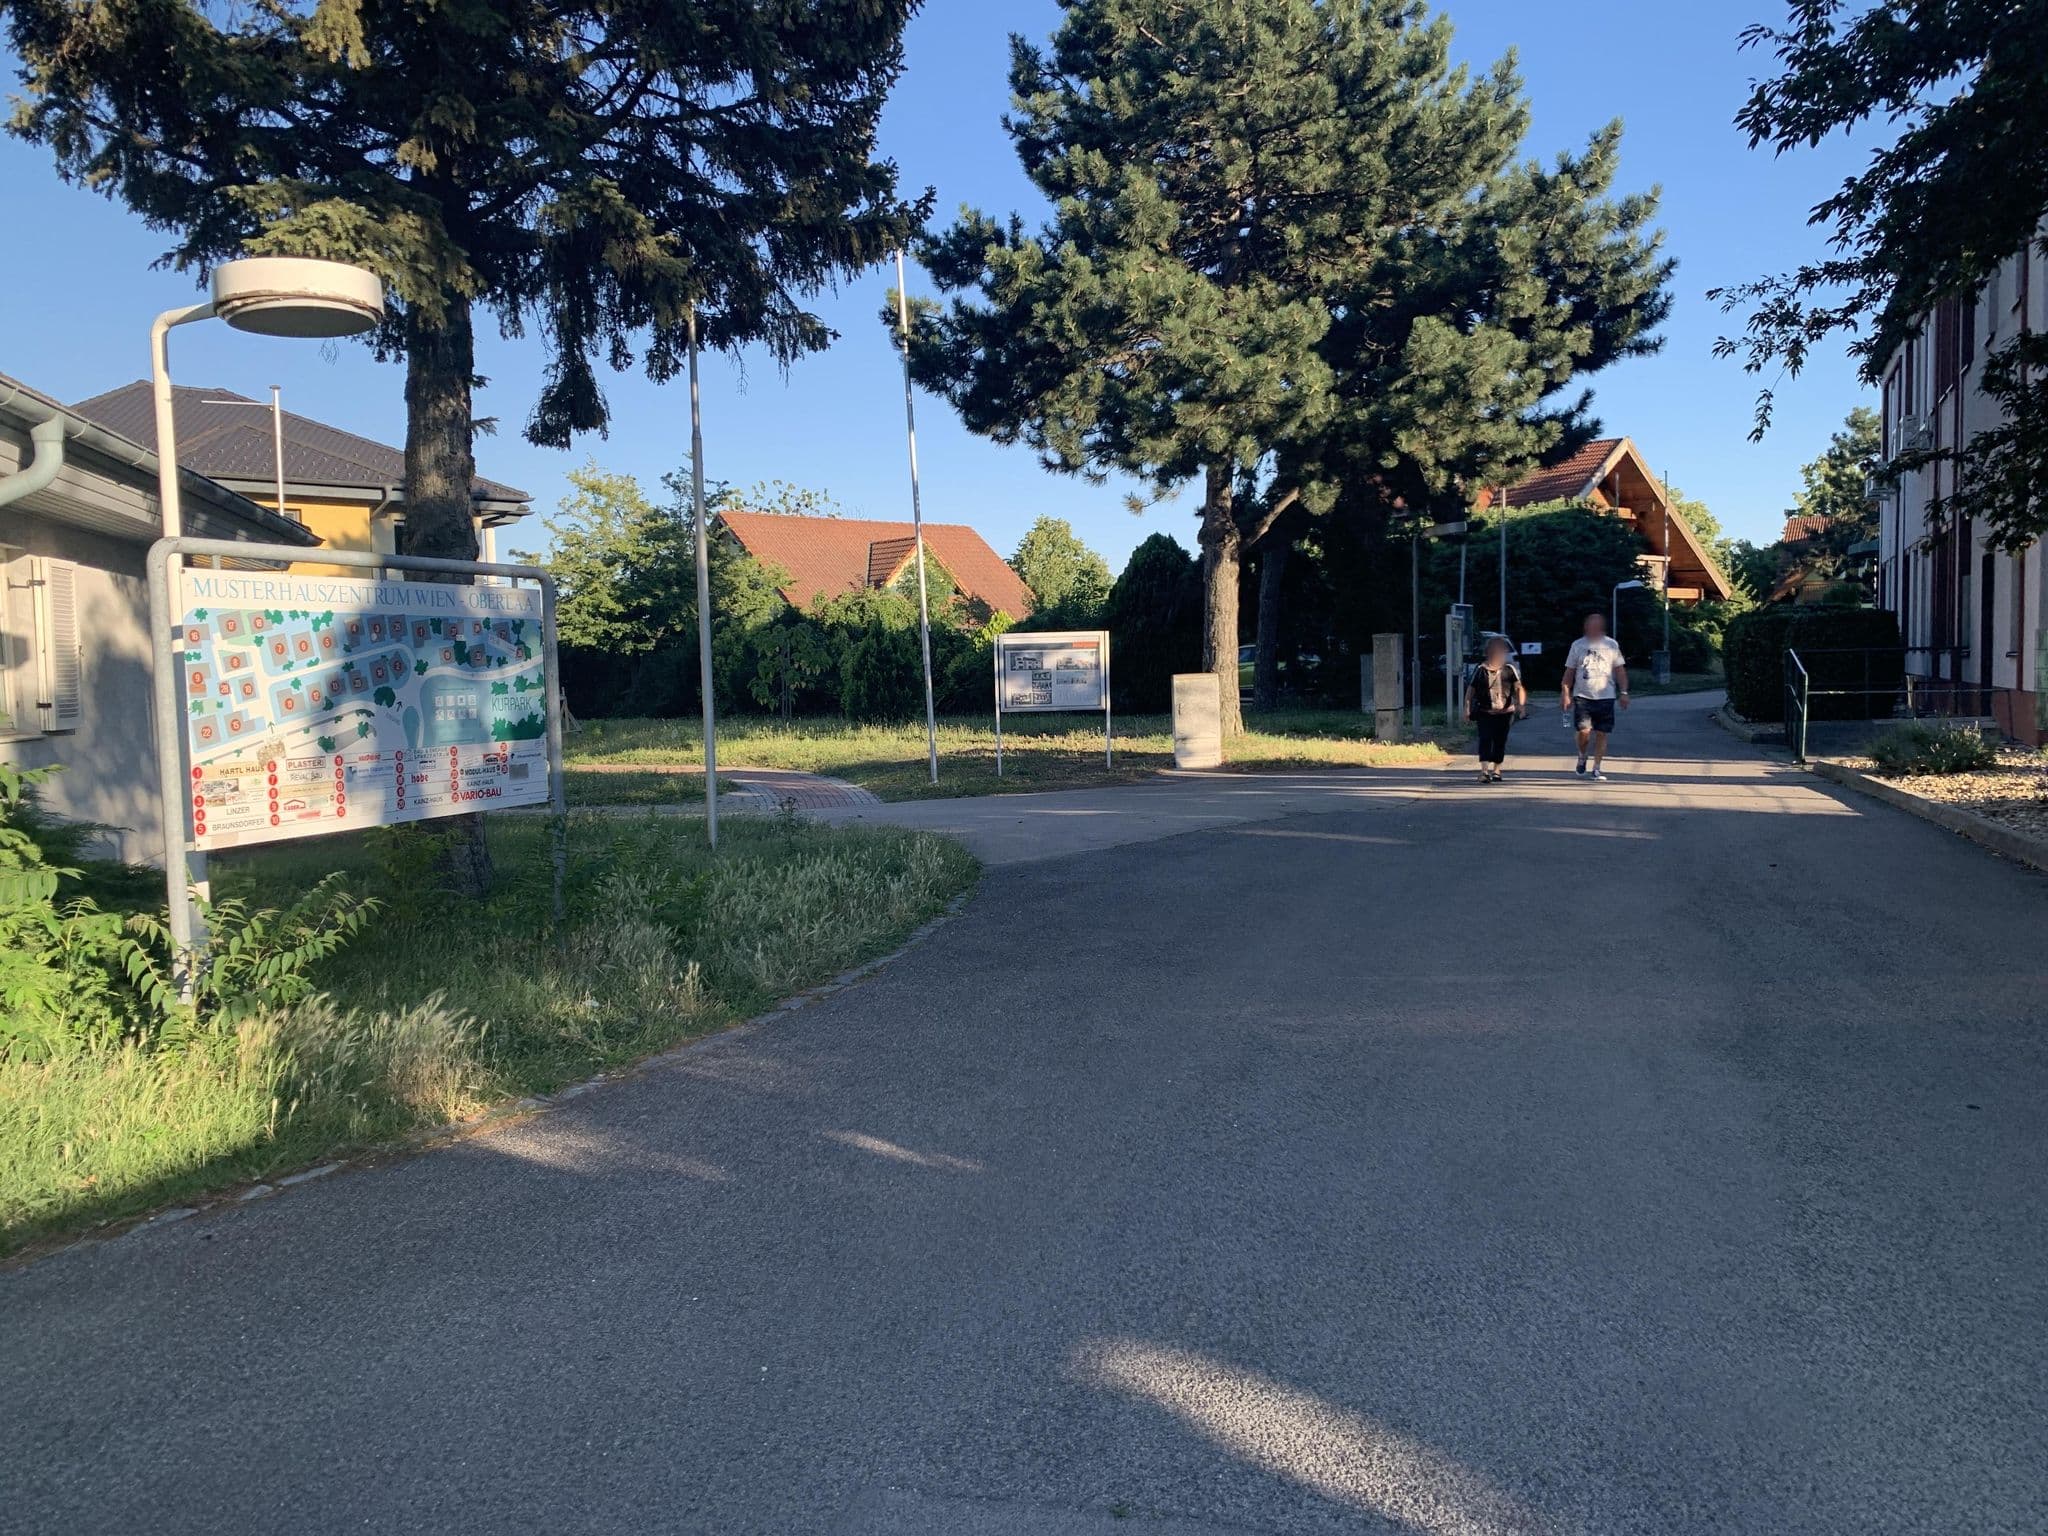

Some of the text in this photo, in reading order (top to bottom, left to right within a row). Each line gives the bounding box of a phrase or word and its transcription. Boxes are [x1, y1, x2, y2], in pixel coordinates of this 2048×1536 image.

[193, 577, 410, 606] MUSTERHAUSZENTRUM
[416, 589, 456, 608] WIEN
[469, 592, 534, 611] OBERLAA
[491, 697, 532, 711] KURPARK
[220, 768, 243, 776] HARTL
[245, 766, 264, 774] HAUS
[460, 787, 502, 800] VARIO-BAU
[226, 807, 250, 815] LINZER
[212, 818, 264, 831] BRAUNSDORFER
